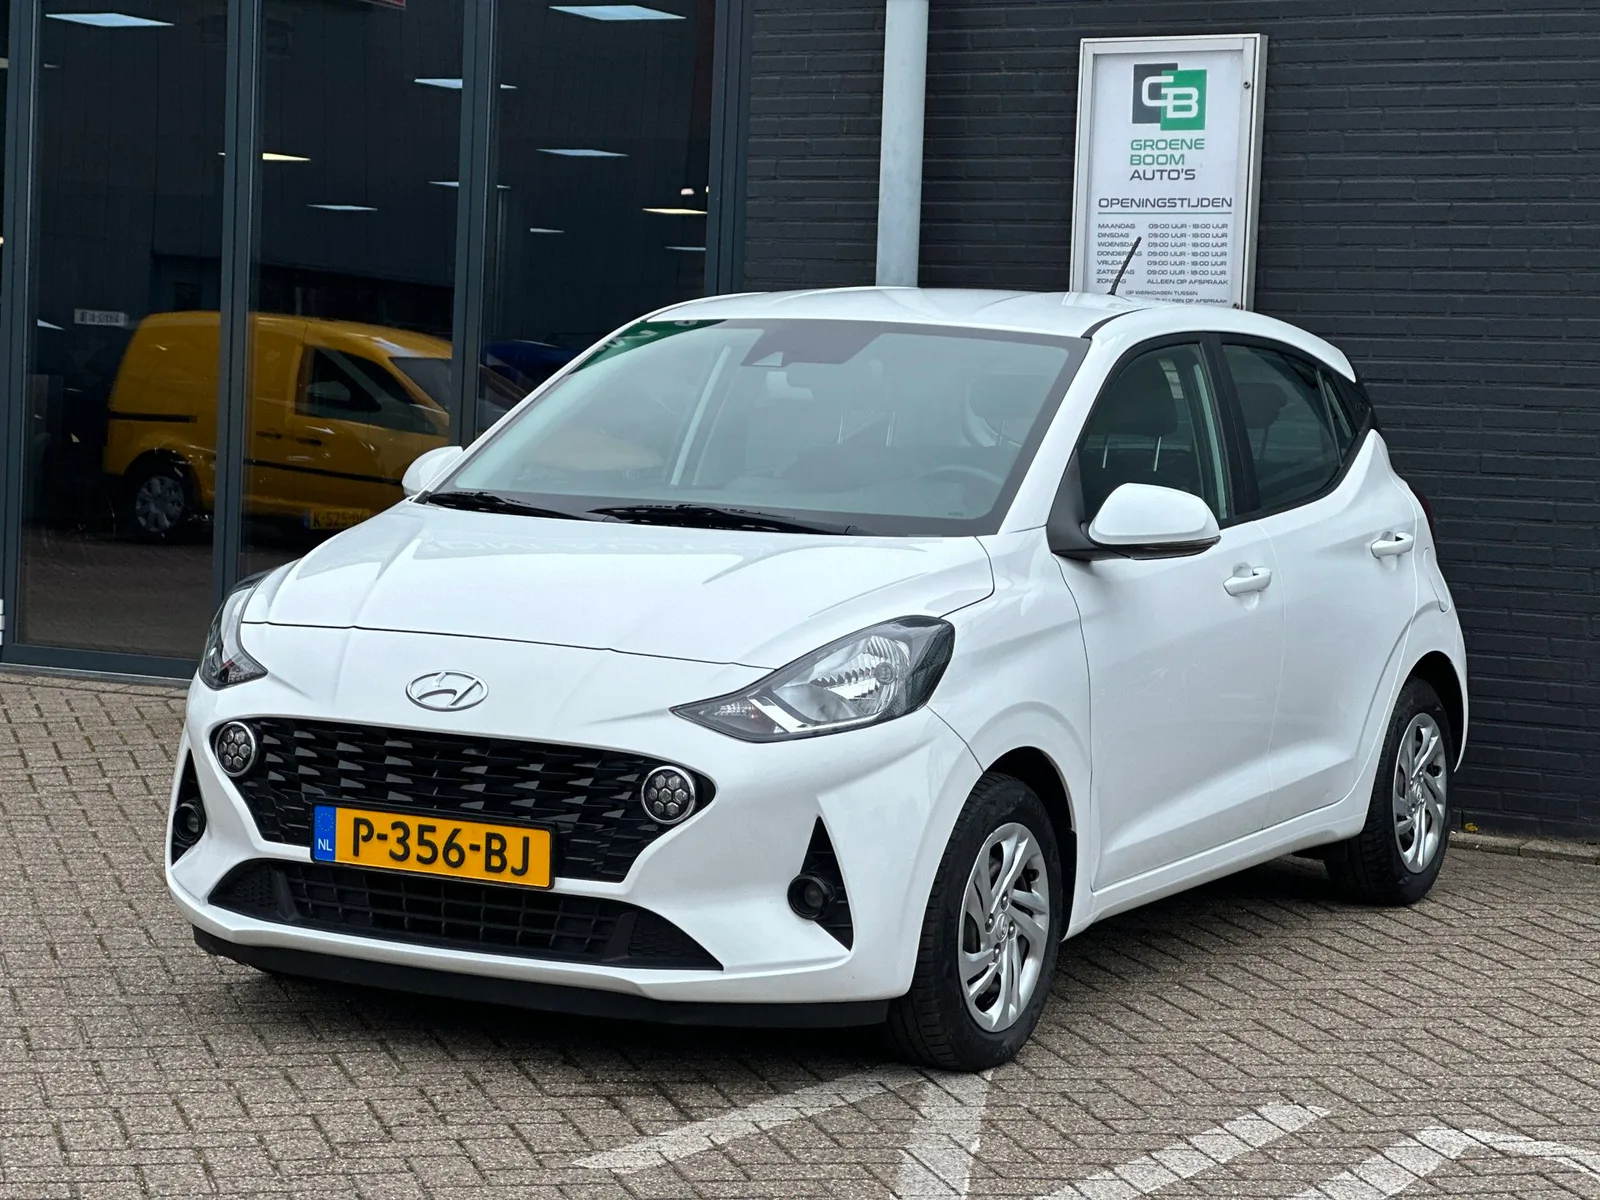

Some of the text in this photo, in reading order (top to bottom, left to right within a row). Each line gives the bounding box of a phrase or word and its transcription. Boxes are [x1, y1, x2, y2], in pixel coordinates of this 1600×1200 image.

[1131, 138, 1205, 151] GROENE
[1130, 154, 1185, 166] BOOM
[1129, 169, 1196, 181] AUTO'S
[1098, 197, 1232, 208] OPENINGSTIJDEN
[318, 817, 530, 876] NL P-356-BJ
